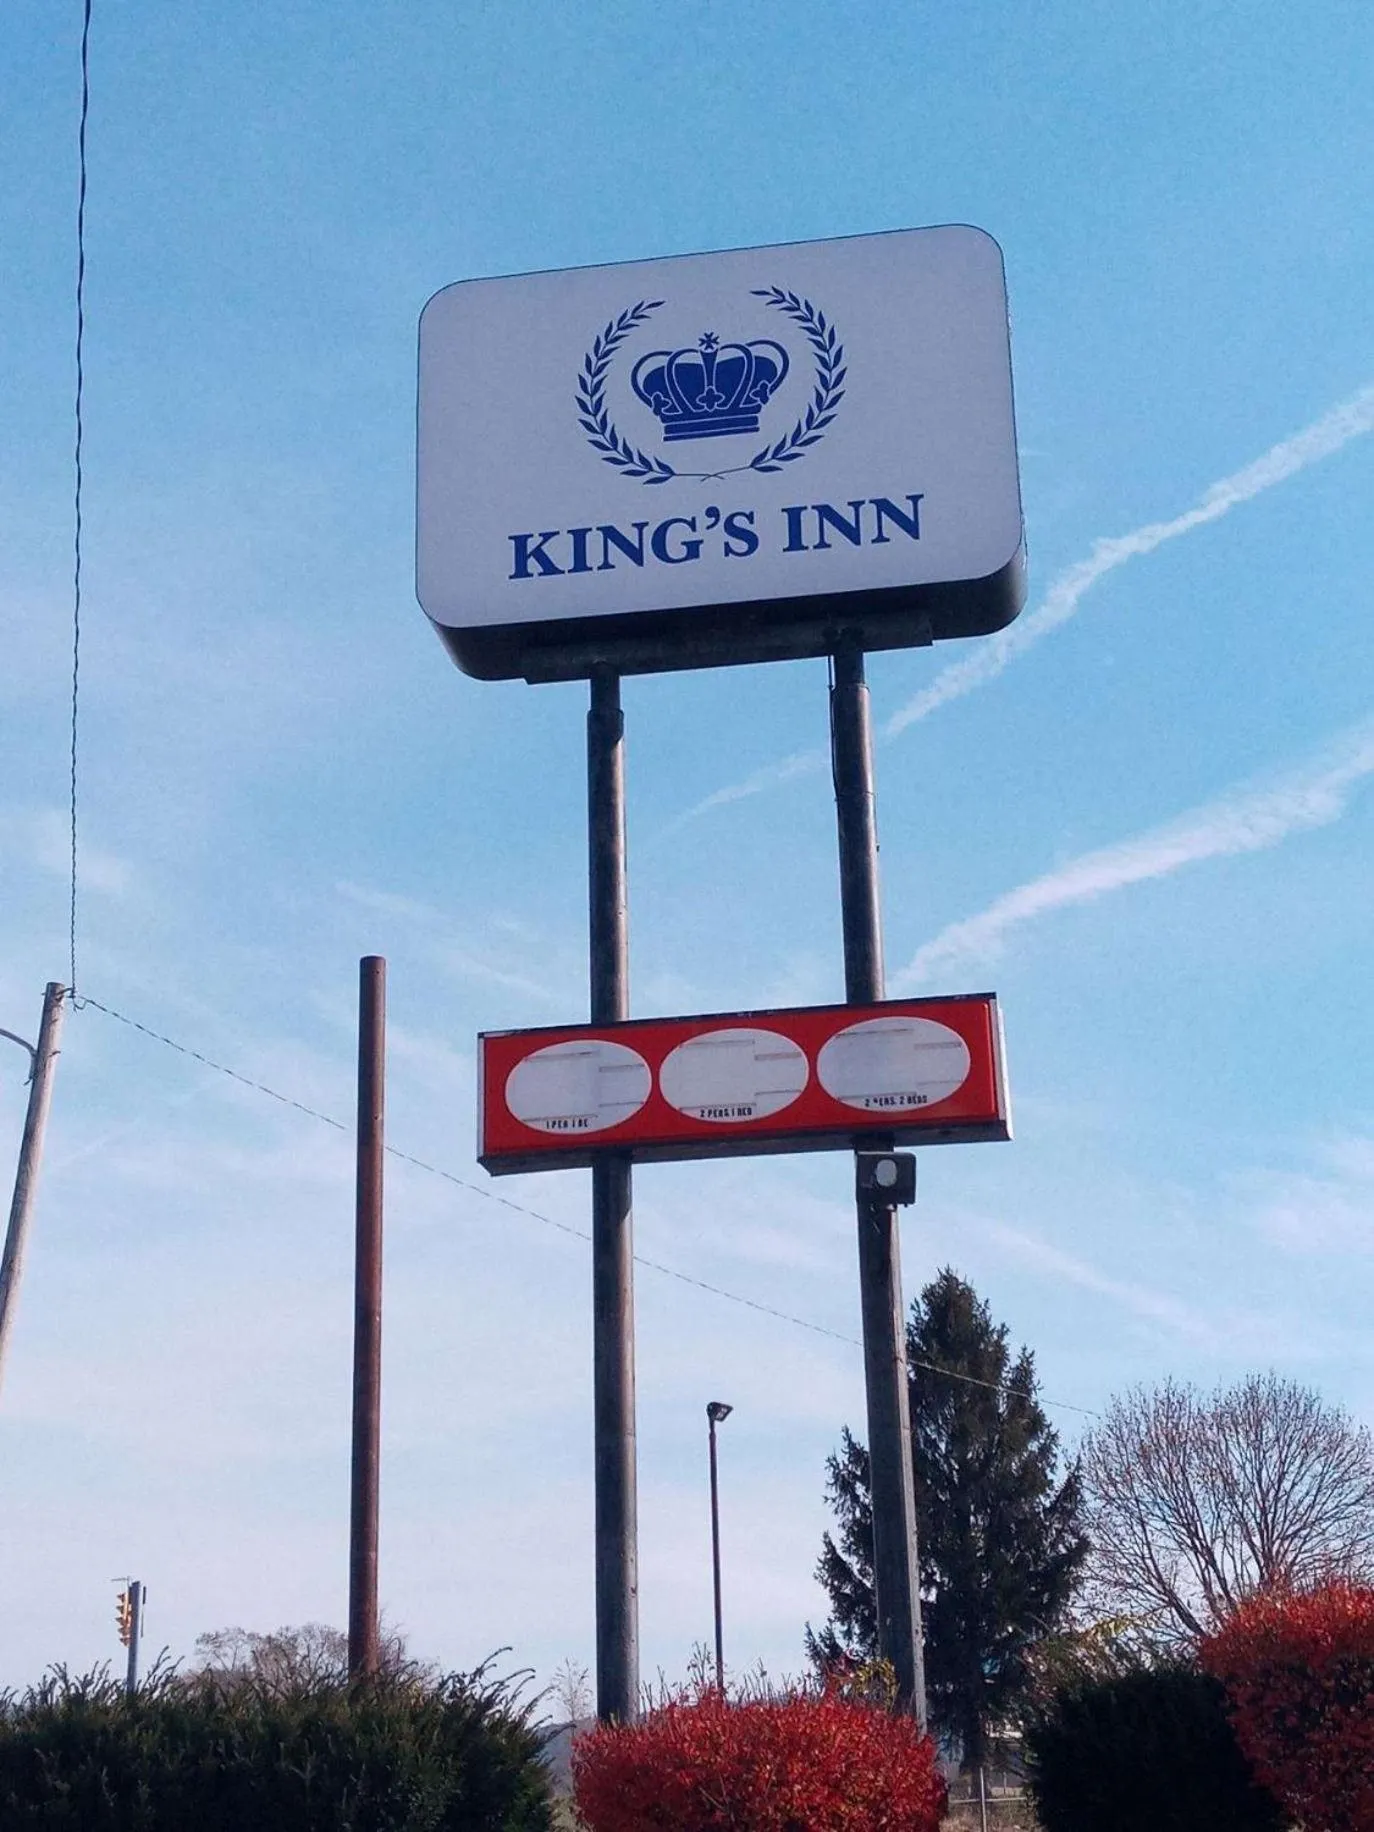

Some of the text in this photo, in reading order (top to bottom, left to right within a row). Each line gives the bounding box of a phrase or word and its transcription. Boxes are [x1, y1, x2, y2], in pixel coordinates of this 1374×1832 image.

[507, 493, 925, 580] KING'S INN
[864, 1098, 870, 1107] 2
[899, 1095, 905, 1105] 2
[700, 1108, 705, 1118] 2
